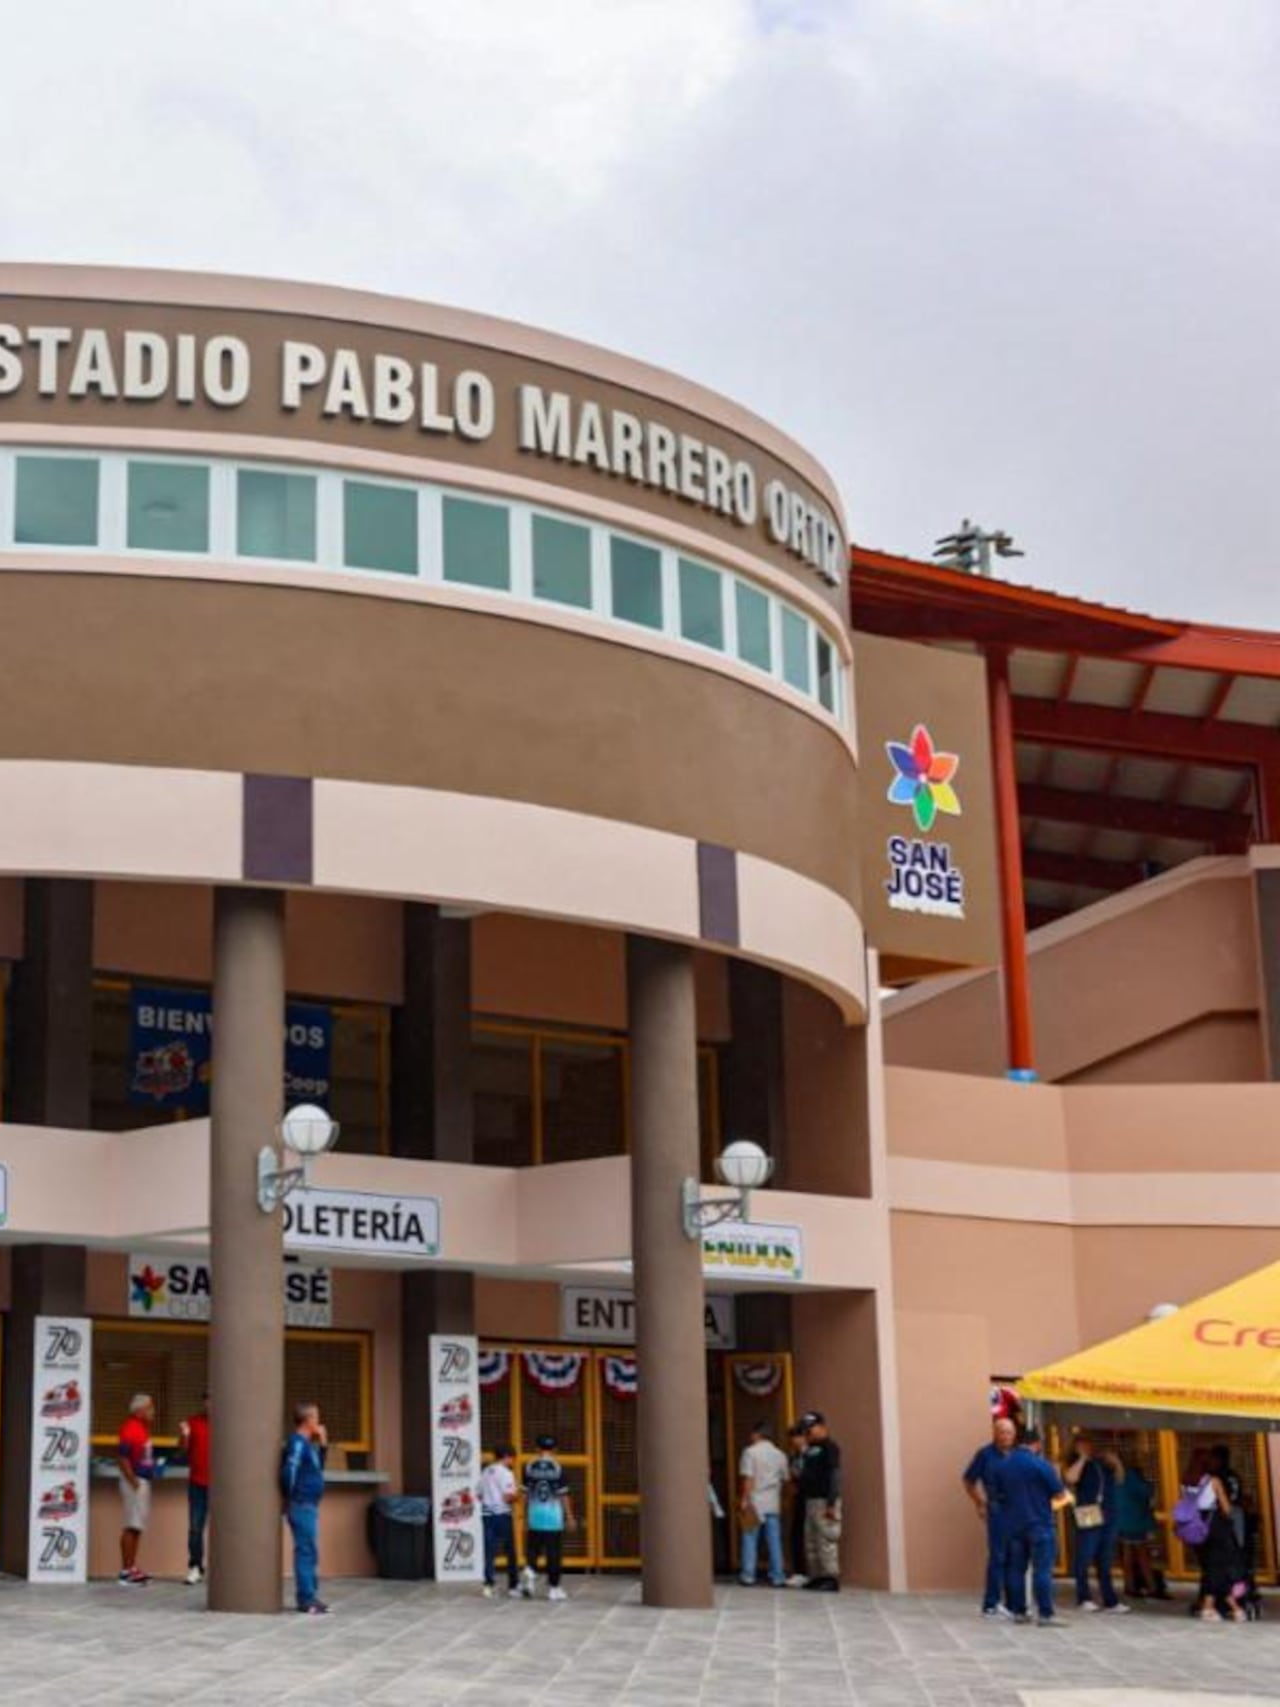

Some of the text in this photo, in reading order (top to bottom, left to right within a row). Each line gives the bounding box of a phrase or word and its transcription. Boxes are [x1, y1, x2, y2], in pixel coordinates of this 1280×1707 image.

[282, 341, 495, 441] PABLO
[520, 386, 757, 527] MARRERO
[890, 838, 949, 873] SAN
[887, 868, 962, 904] JOSÉ
[576, 1297, 719, 1334] ENTA
[45, 1326, 82, 1361] 70
[440, 1343, 470, 1378] 70
[42, 1427, 79, 1462] 70
[440, 1437, 471, 1471] 70
[40, 1527, 77, 1563] 70
[443, 1530, 475, 1565] 70
